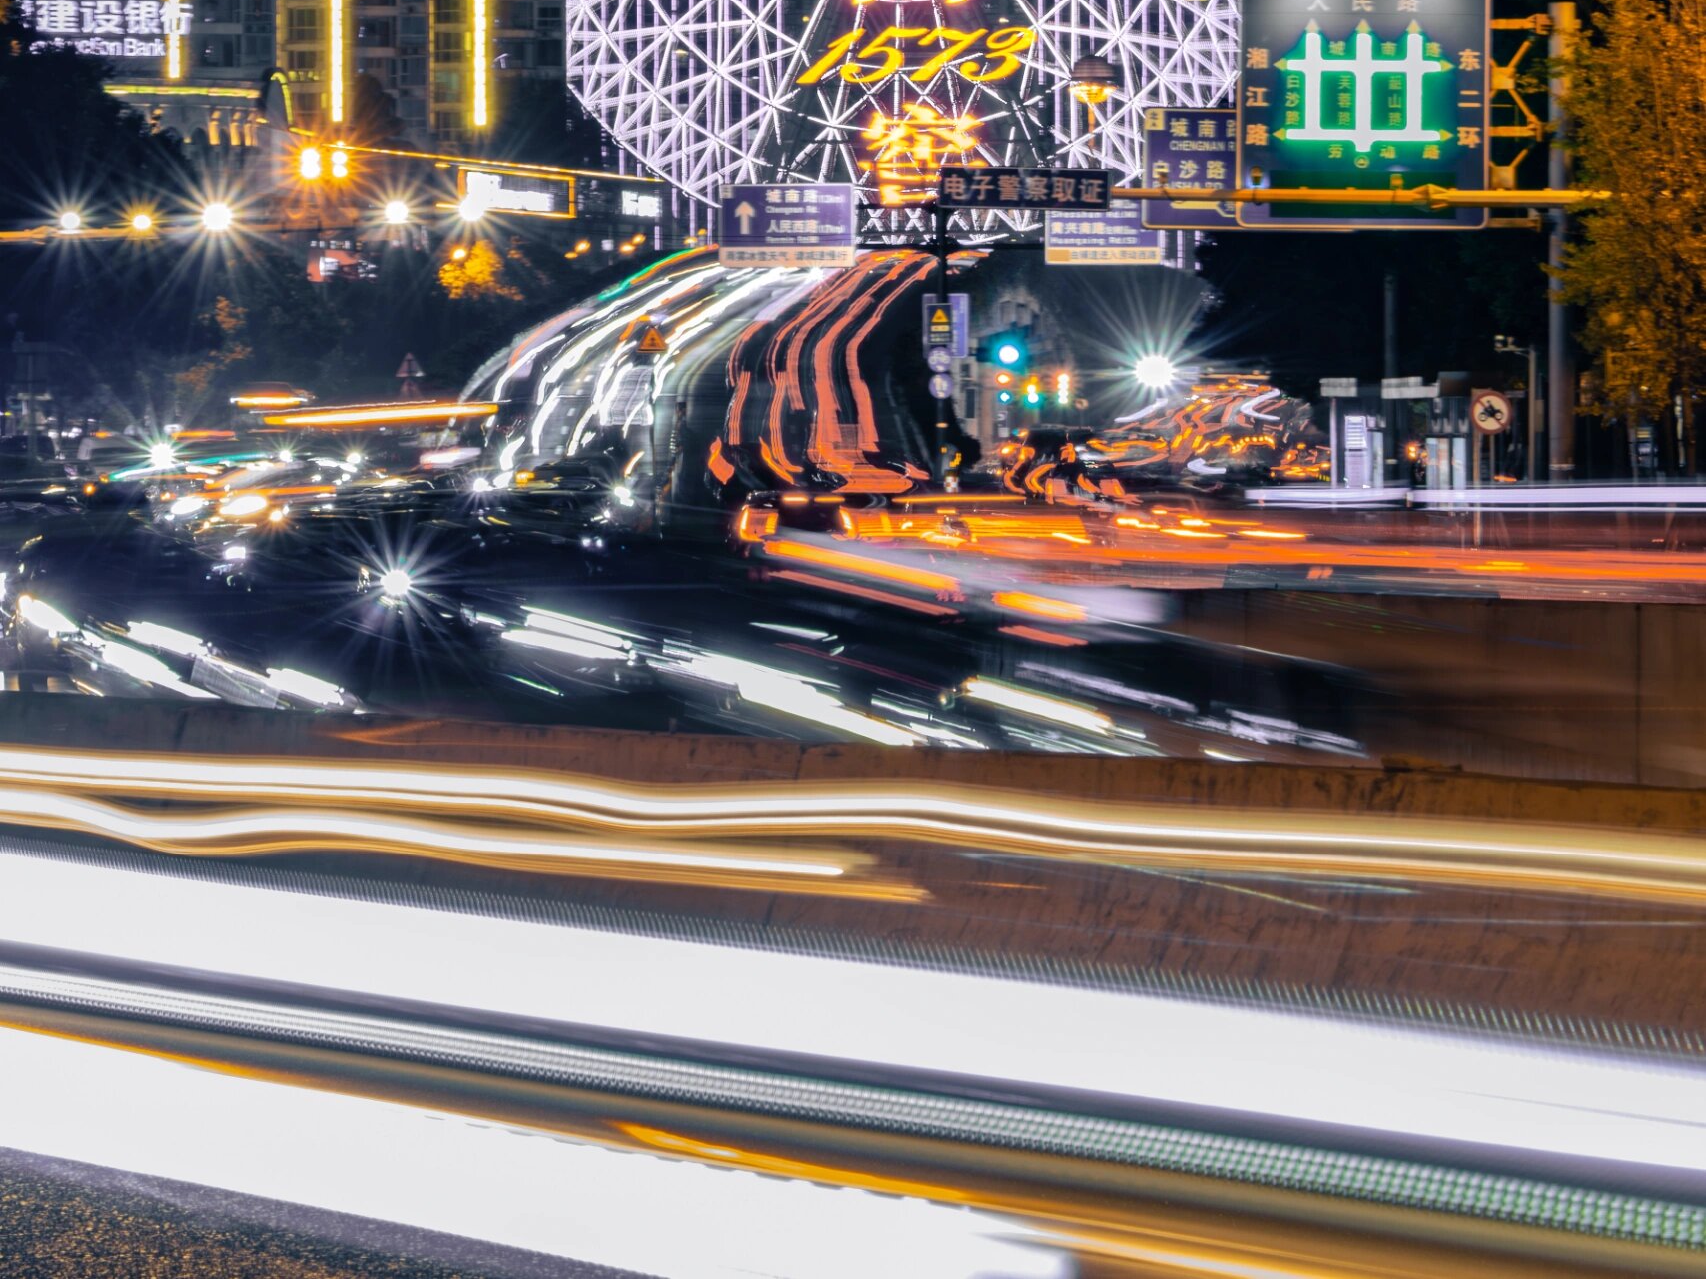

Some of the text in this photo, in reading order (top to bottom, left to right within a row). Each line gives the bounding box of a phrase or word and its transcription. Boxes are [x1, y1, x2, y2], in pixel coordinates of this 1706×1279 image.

[20, 0, 194, 35] 建设银行
[123, 38, 167, 56] Bank
[796, 26, 1037, 85] 1573
[1329, 41, 1442, 58] 城南路
[1246, 48, 1270, 146] 湘江路
[1285, 75, 1301, 126] 白沙路
[1457, 49, 1481, 148] 东二环
[1152, 160, 1227, 180] 白沙路
[944, 174, 1104, 203] 电子警察取证
[766, 220, 818, 234] 人民西路
